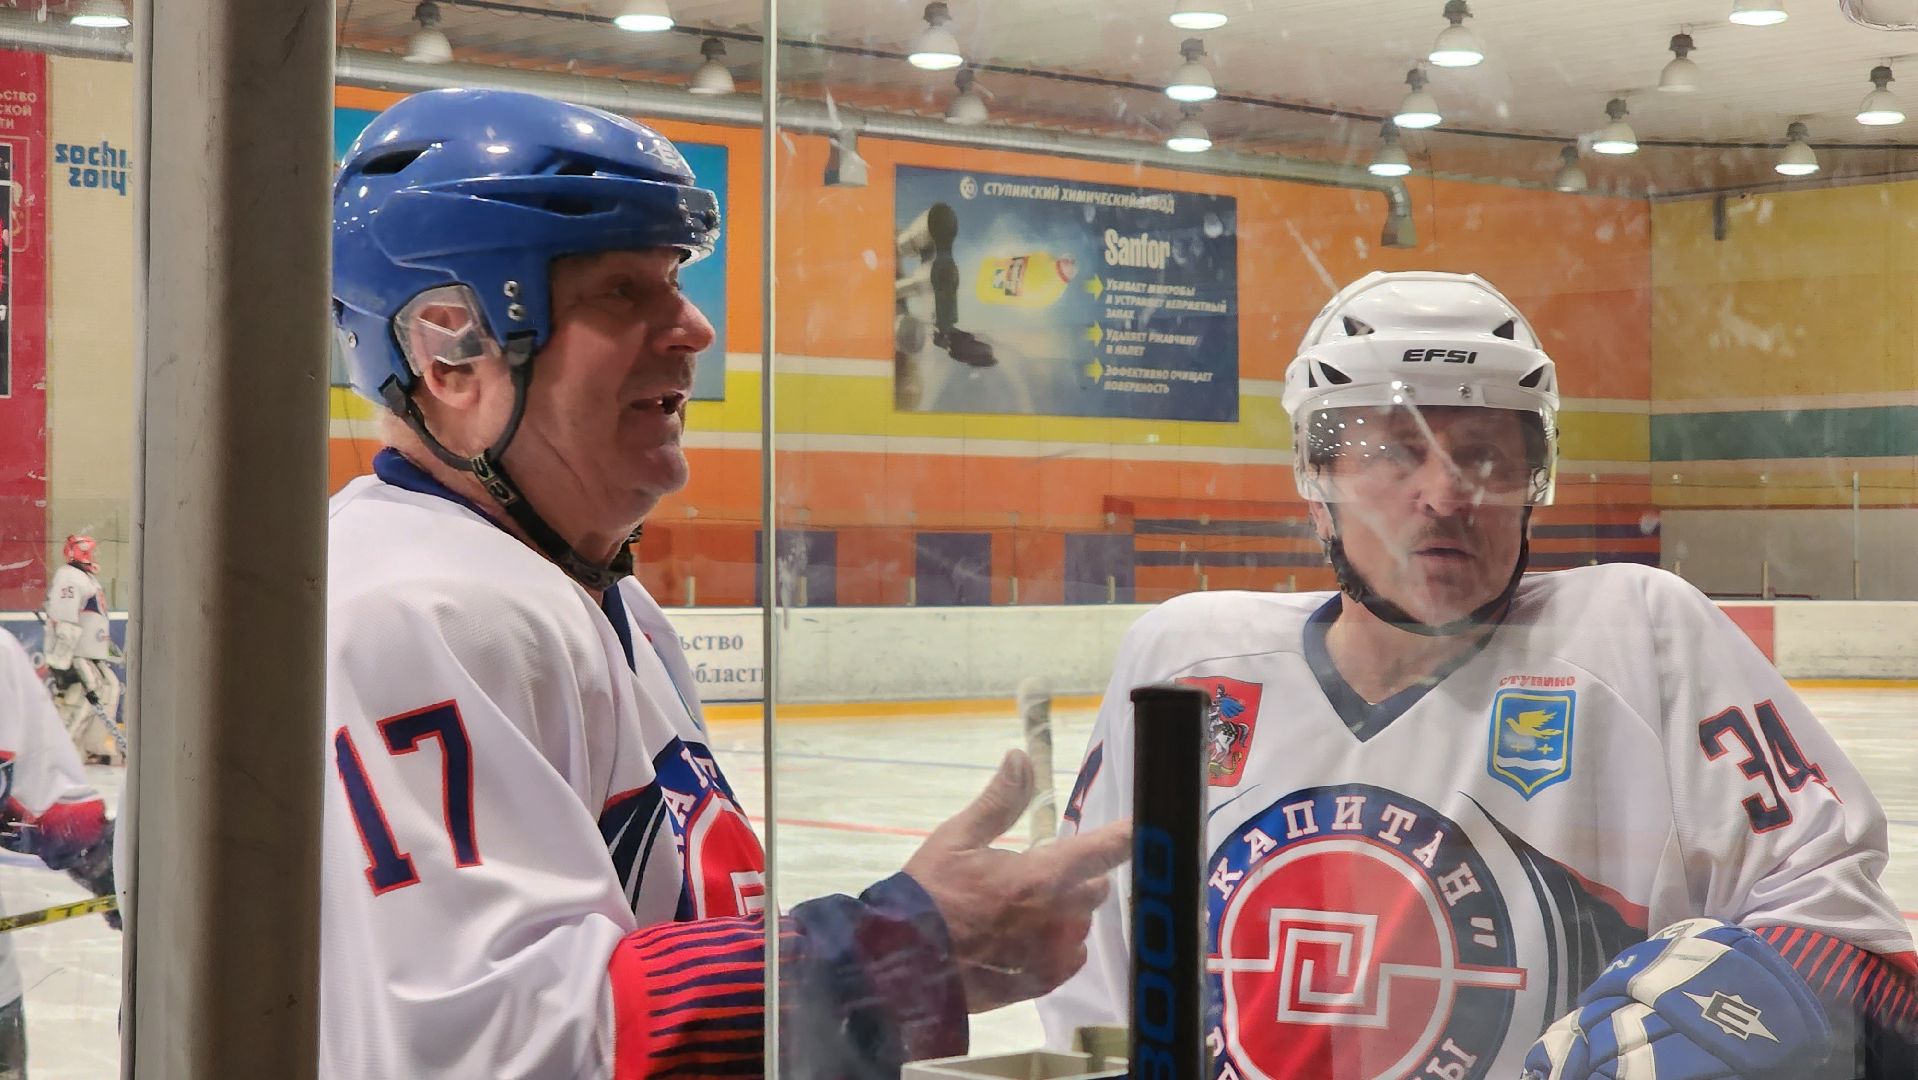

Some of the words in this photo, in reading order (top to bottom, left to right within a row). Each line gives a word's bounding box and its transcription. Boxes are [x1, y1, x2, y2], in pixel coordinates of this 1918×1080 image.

[55, 141, 127, 168] sochi
[69, 167, 127, 197] 2014
[983, 181, 1060, 201] СТУПИНСКИЙ
[1060, 187, 1137, 208] ХИМИЧЕСКИЙ
[1104, 228, 1171, 270] Sanfor
[1402, 348, 1479, 364] EFSI
[691, 662, 764, 684] бласт
[1499, 675, 1577, 688] СТУПИНО
[1698, 698, 1844, 835] 34
[335, 698, 484, 898] 17
